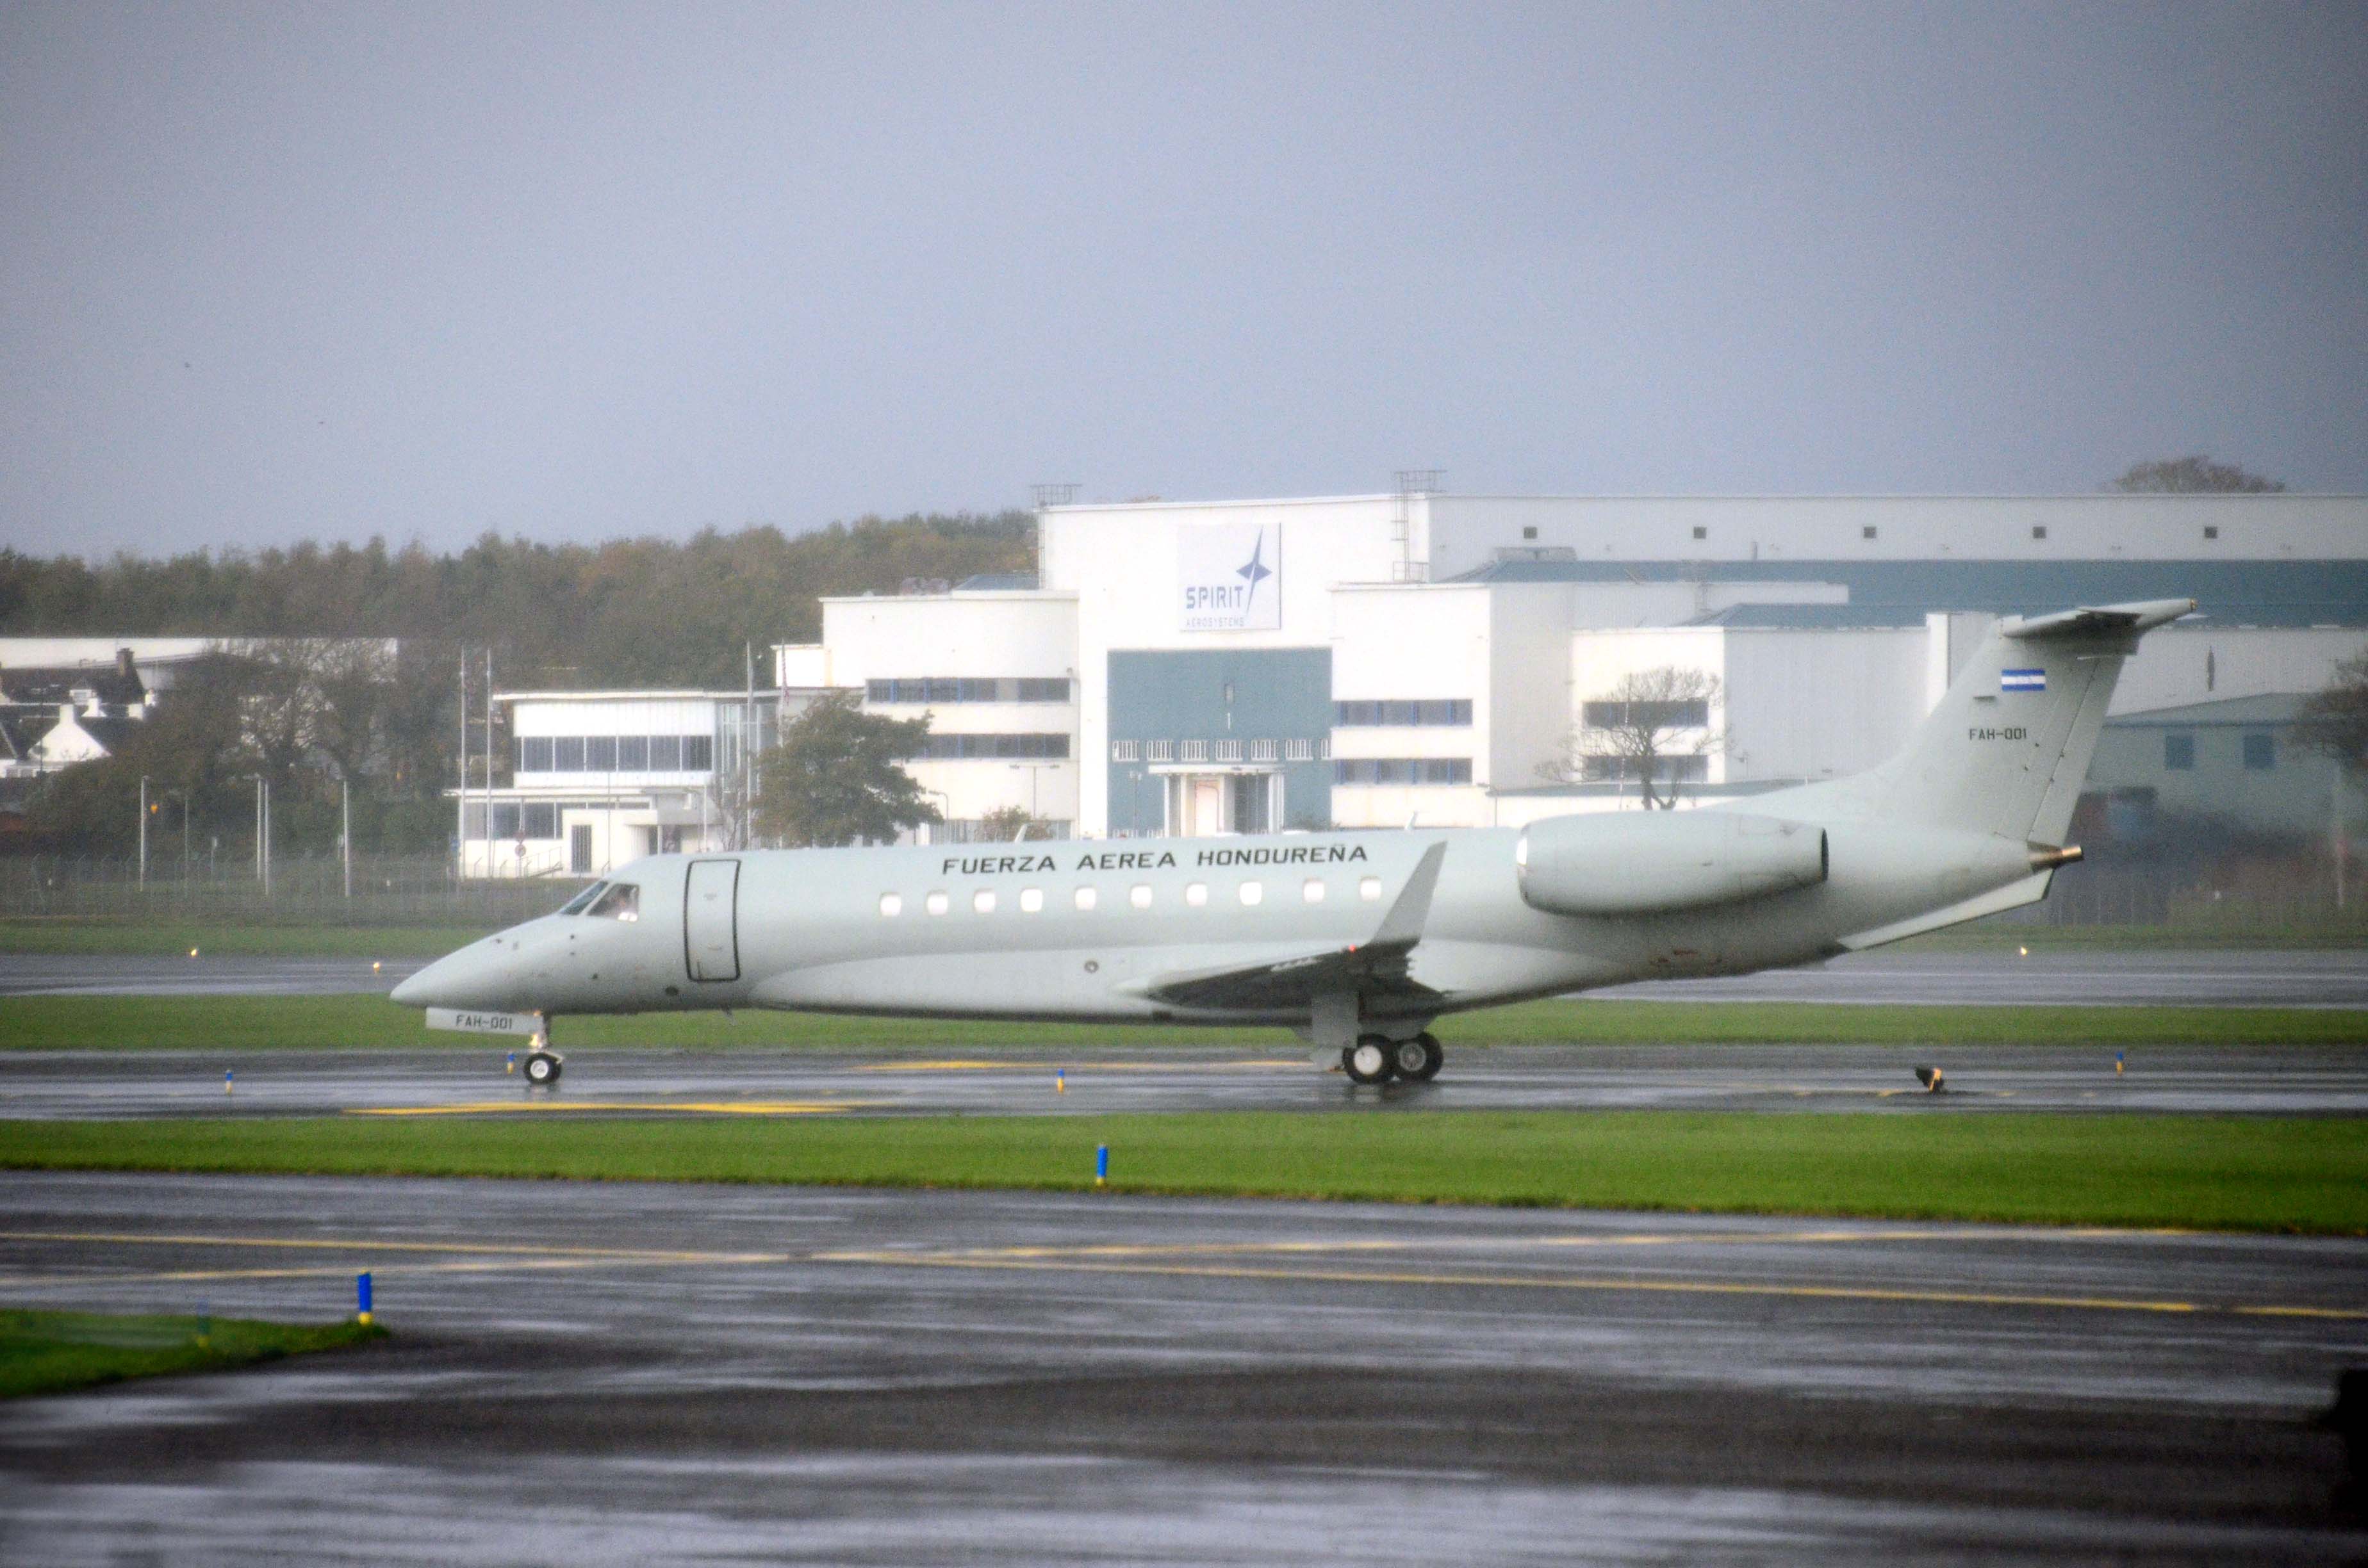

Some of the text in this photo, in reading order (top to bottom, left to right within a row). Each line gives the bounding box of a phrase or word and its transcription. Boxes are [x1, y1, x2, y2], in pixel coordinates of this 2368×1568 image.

[1186, 585, 1244, 608] SPIRIT
[1186, 617, 1244, 627] AEROSYSTEMS
[1969, 728, 2027, 740] FAH-001
[942, 844, 1368, 874] FUERZA AEREA HONDUREÑA
[456, 1014, 513, 1030] FAH-001
